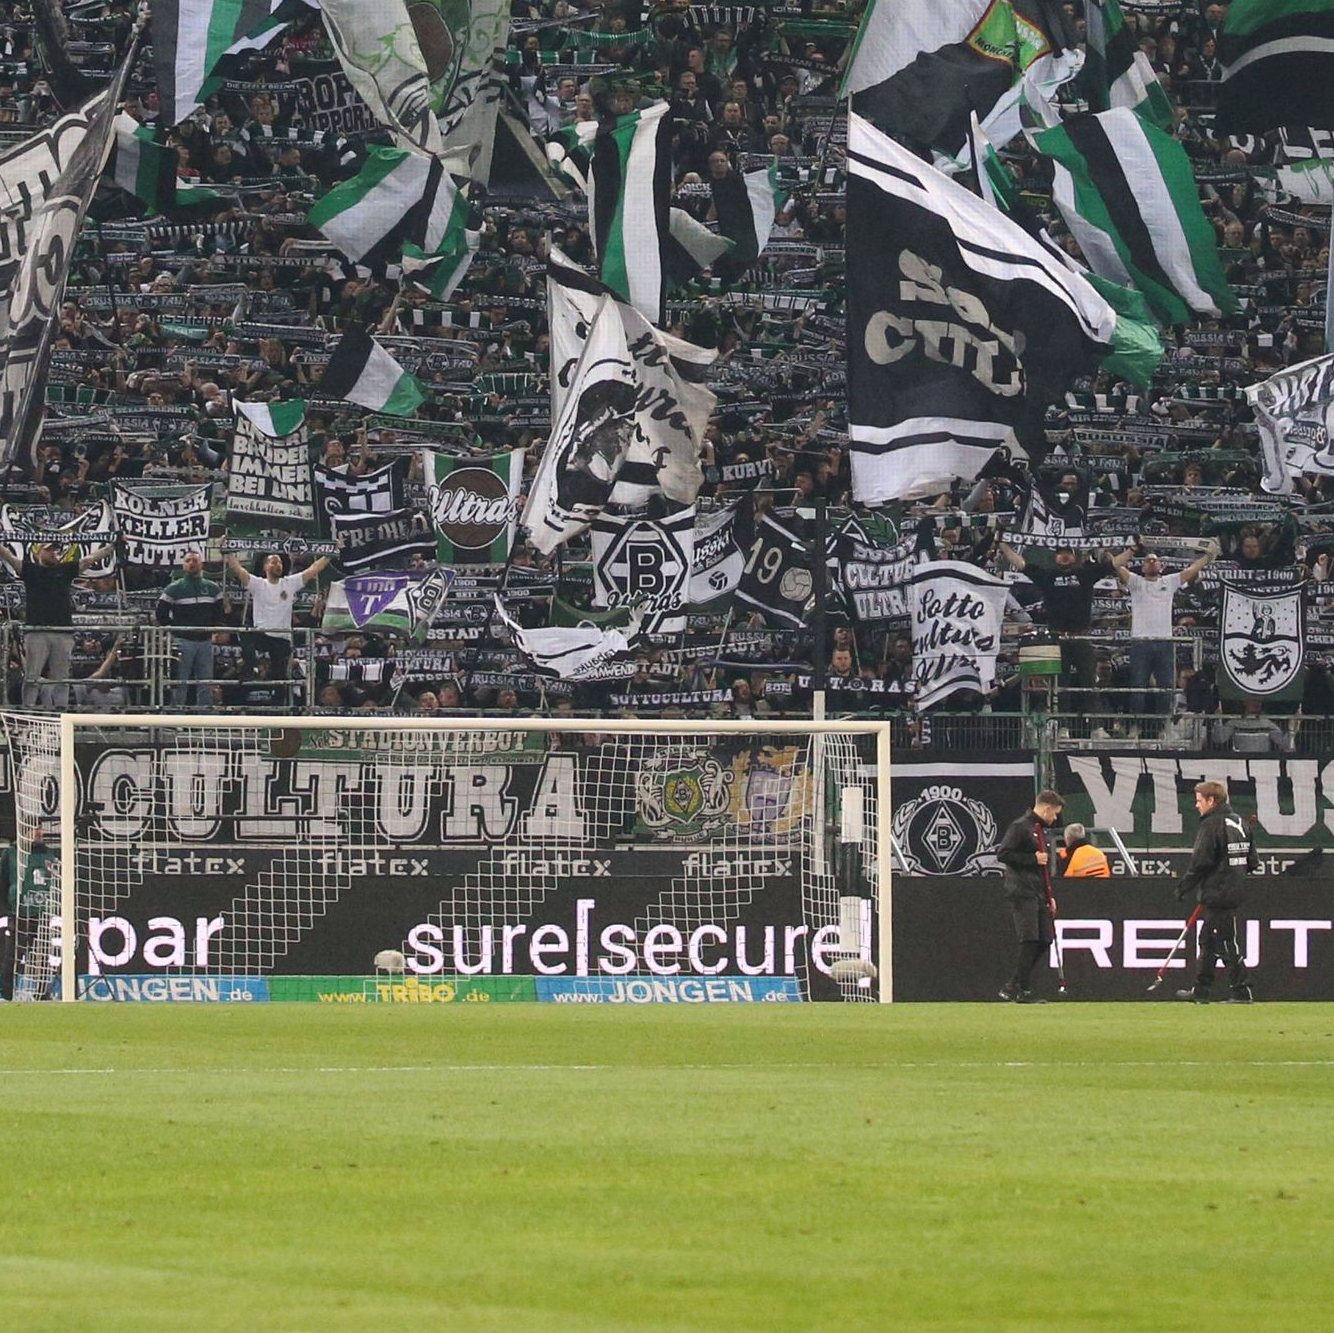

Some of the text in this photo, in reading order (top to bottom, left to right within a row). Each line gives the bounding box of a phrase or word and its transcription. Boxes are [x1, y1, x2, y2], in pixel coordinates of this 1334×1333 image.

[232, 454, 312, 482] IMMER
[722, 459, 772, 480] KURV
[230, 475, 266, 498] BEI
[427, 486, 518, 524] Ultras
[119, 515, 208, 539] KELLER
[1001, 532, 1135, 548] SOTTOCULTURA
[627, 542, 667, 591] B
[743, 537, 783, 584] 19
[844, 562, 913, 585] CULTUR
[1198, 568, 1294, 581] DISTRIKT 1900
[917, 588, 986, 623] Sotto
[798, 674, 916, 692] UTRAS
[609, 689, 734, 704] SOTTOCULTURA
[329, 729, 527, 752] STADIONVERBOT
[923, 786, 962, 800] 1900
